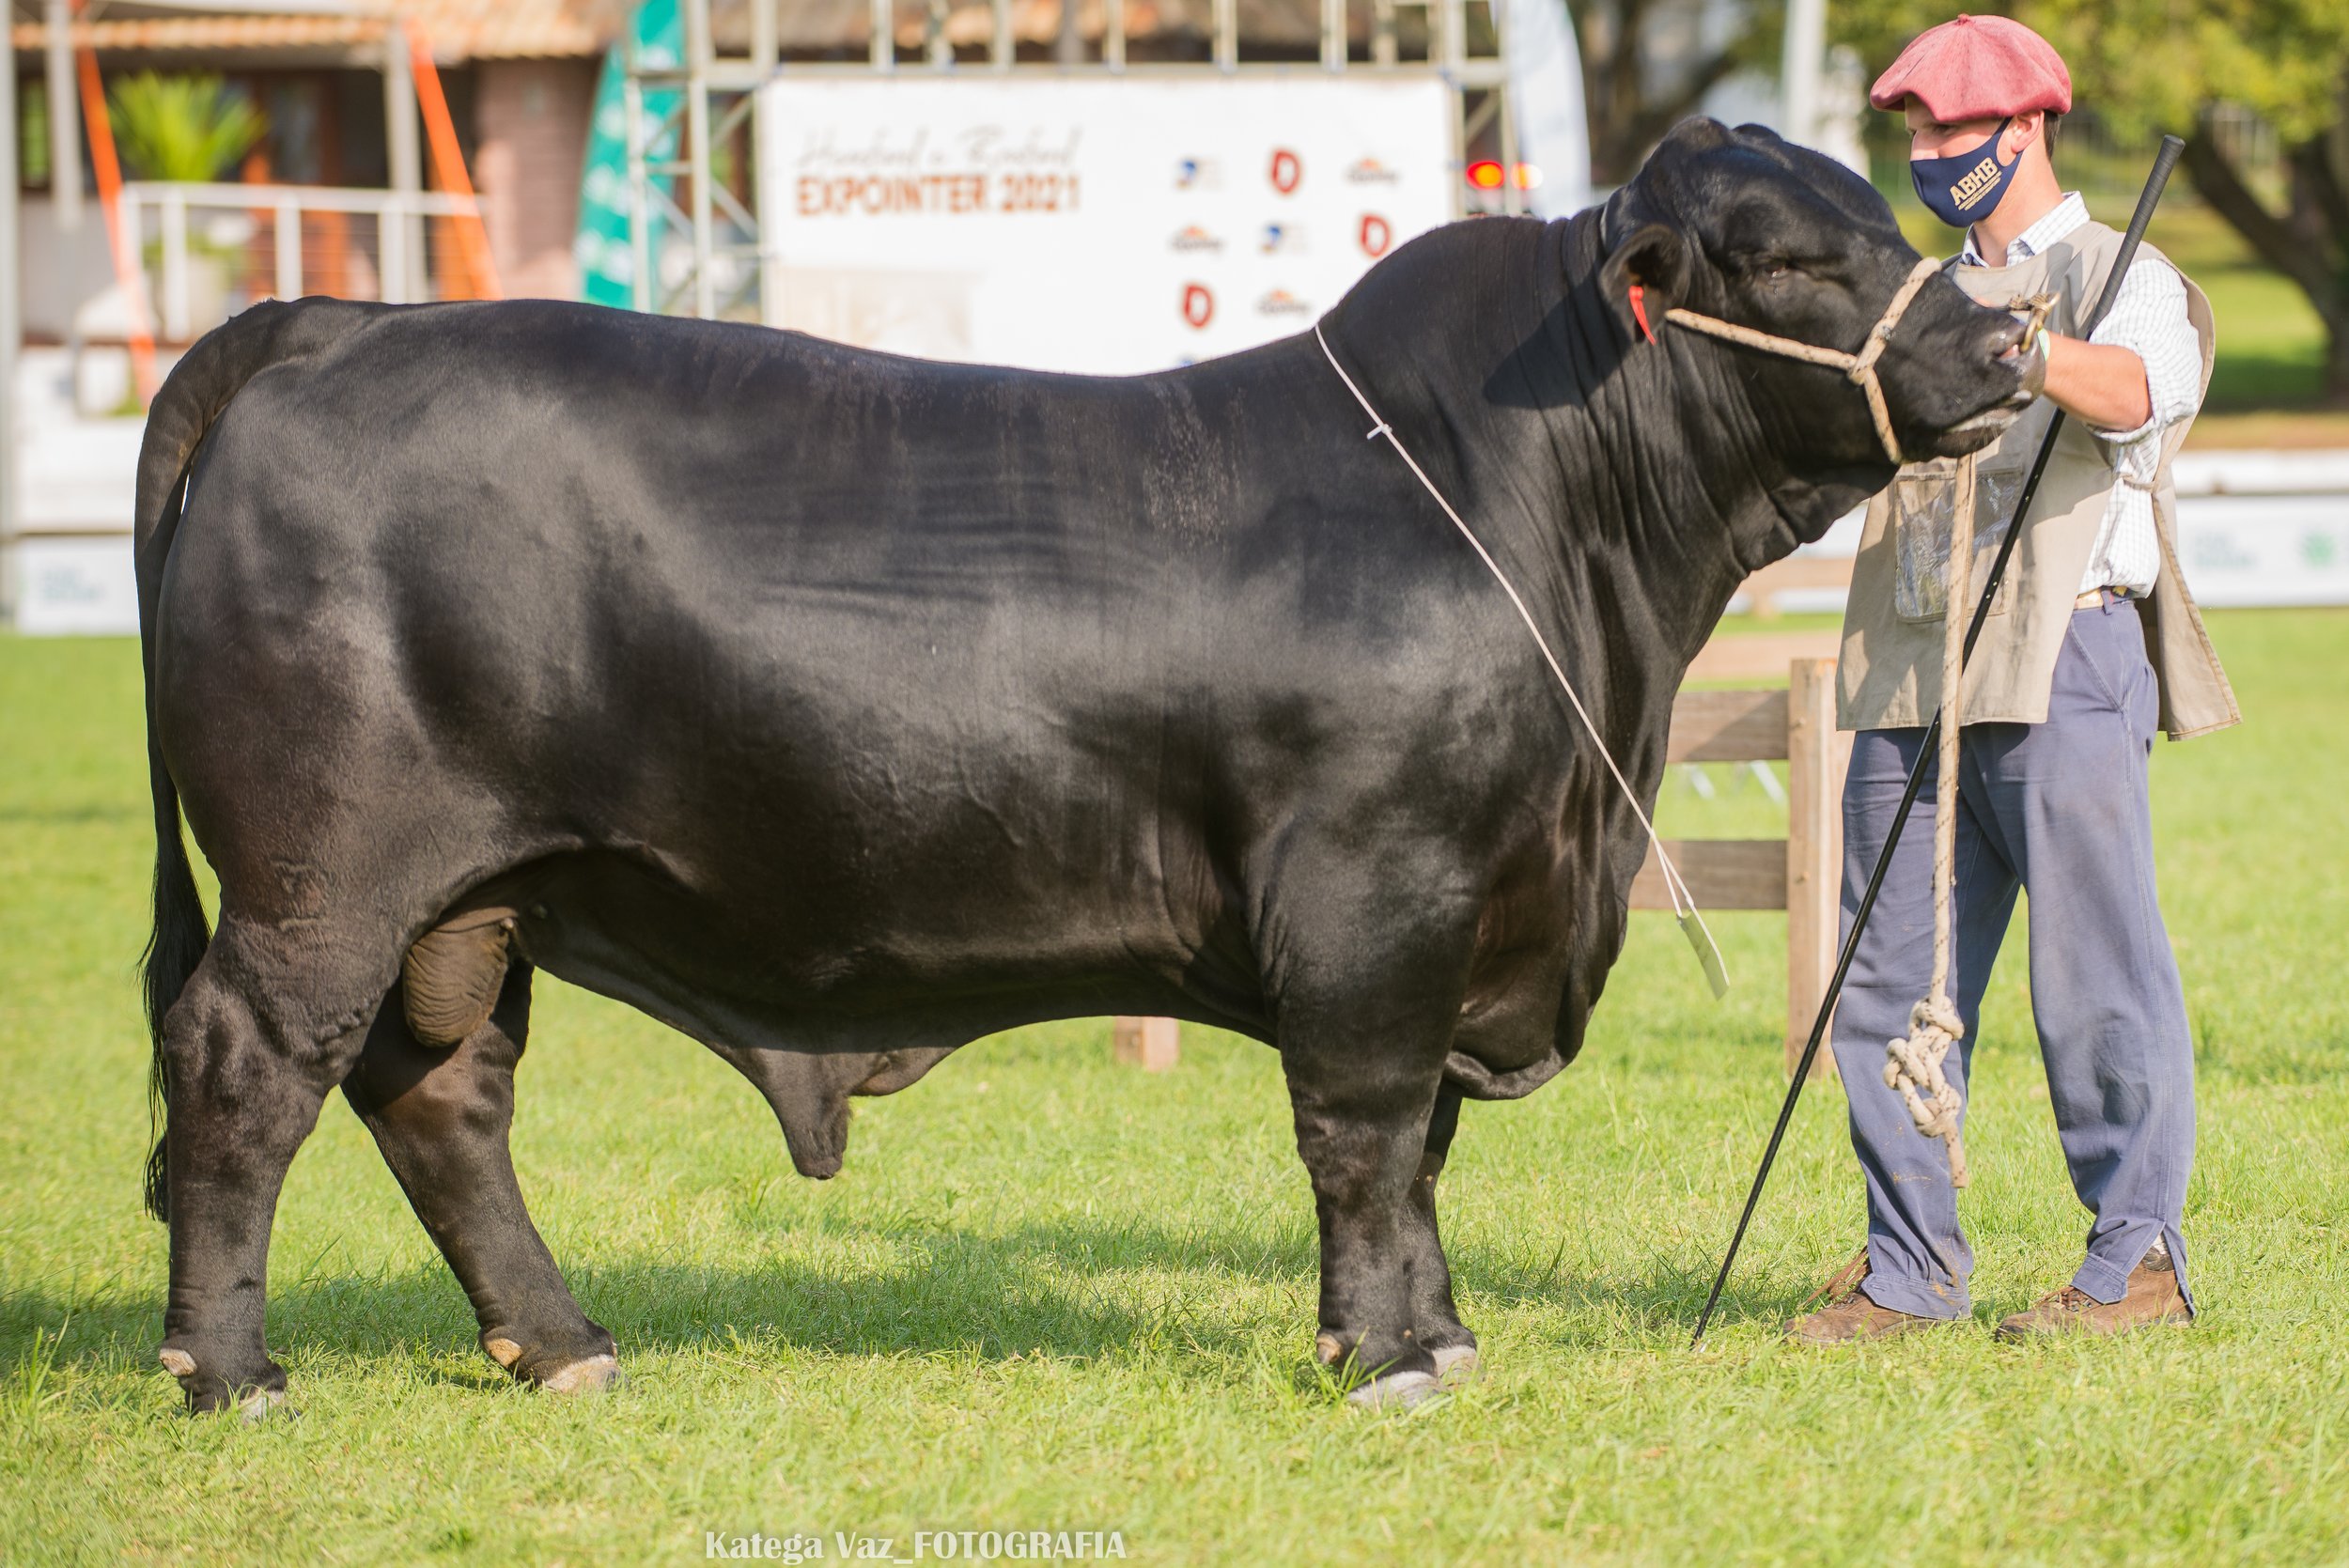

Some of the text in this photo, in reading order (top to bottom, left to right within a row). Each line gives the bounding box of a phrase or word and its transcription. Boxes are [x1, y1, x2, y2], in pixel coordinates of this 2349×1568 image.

[796, 174, 1081, 215] EXPOINTER 2021
[1949, 156, 1999, 207] ABHB
